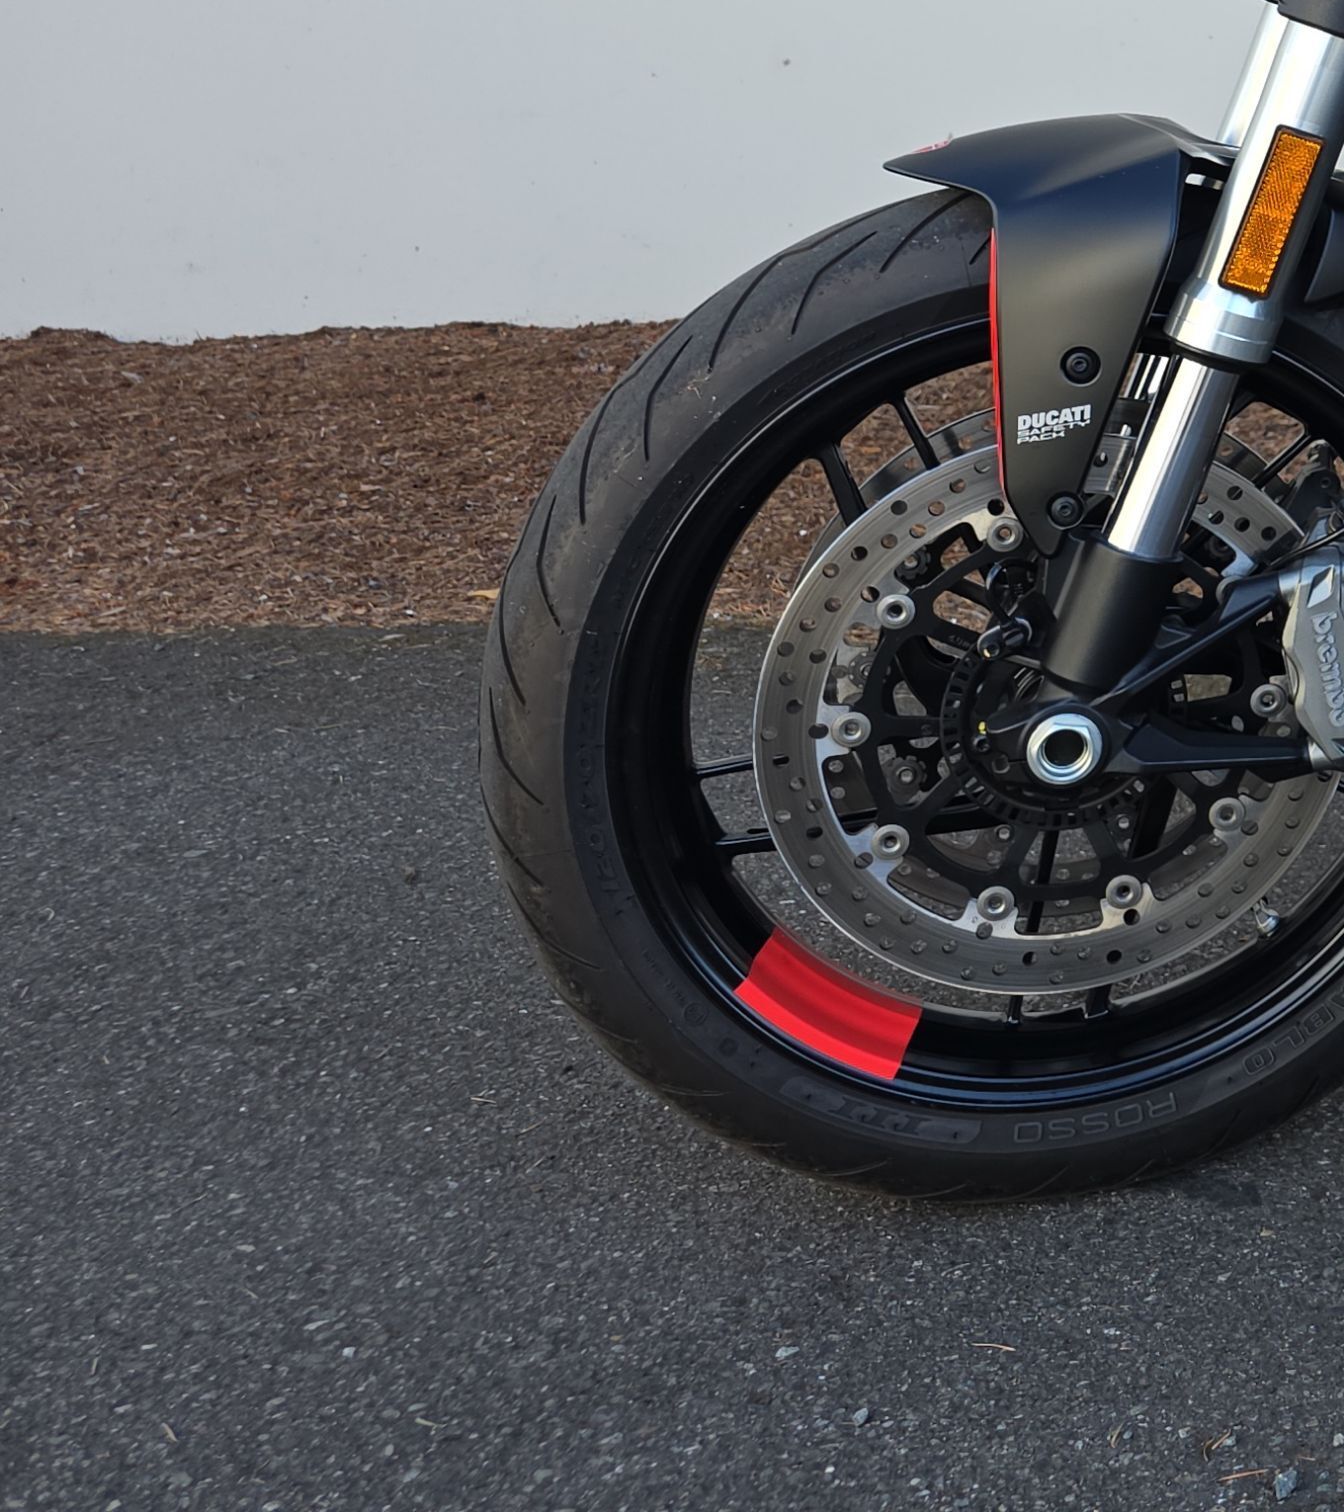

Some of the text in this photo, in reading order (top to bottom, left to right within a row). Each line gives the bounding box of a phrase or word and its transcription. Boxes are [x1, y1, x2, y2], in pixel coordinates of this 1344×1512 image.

[1017, 403, 1091, 431] DUCATI
[1017, 419, 1091, 438] SAFETY
[1017, 431, 1065, 445] PACK
[1012, 1089, 1181, 1143] ROSSO
